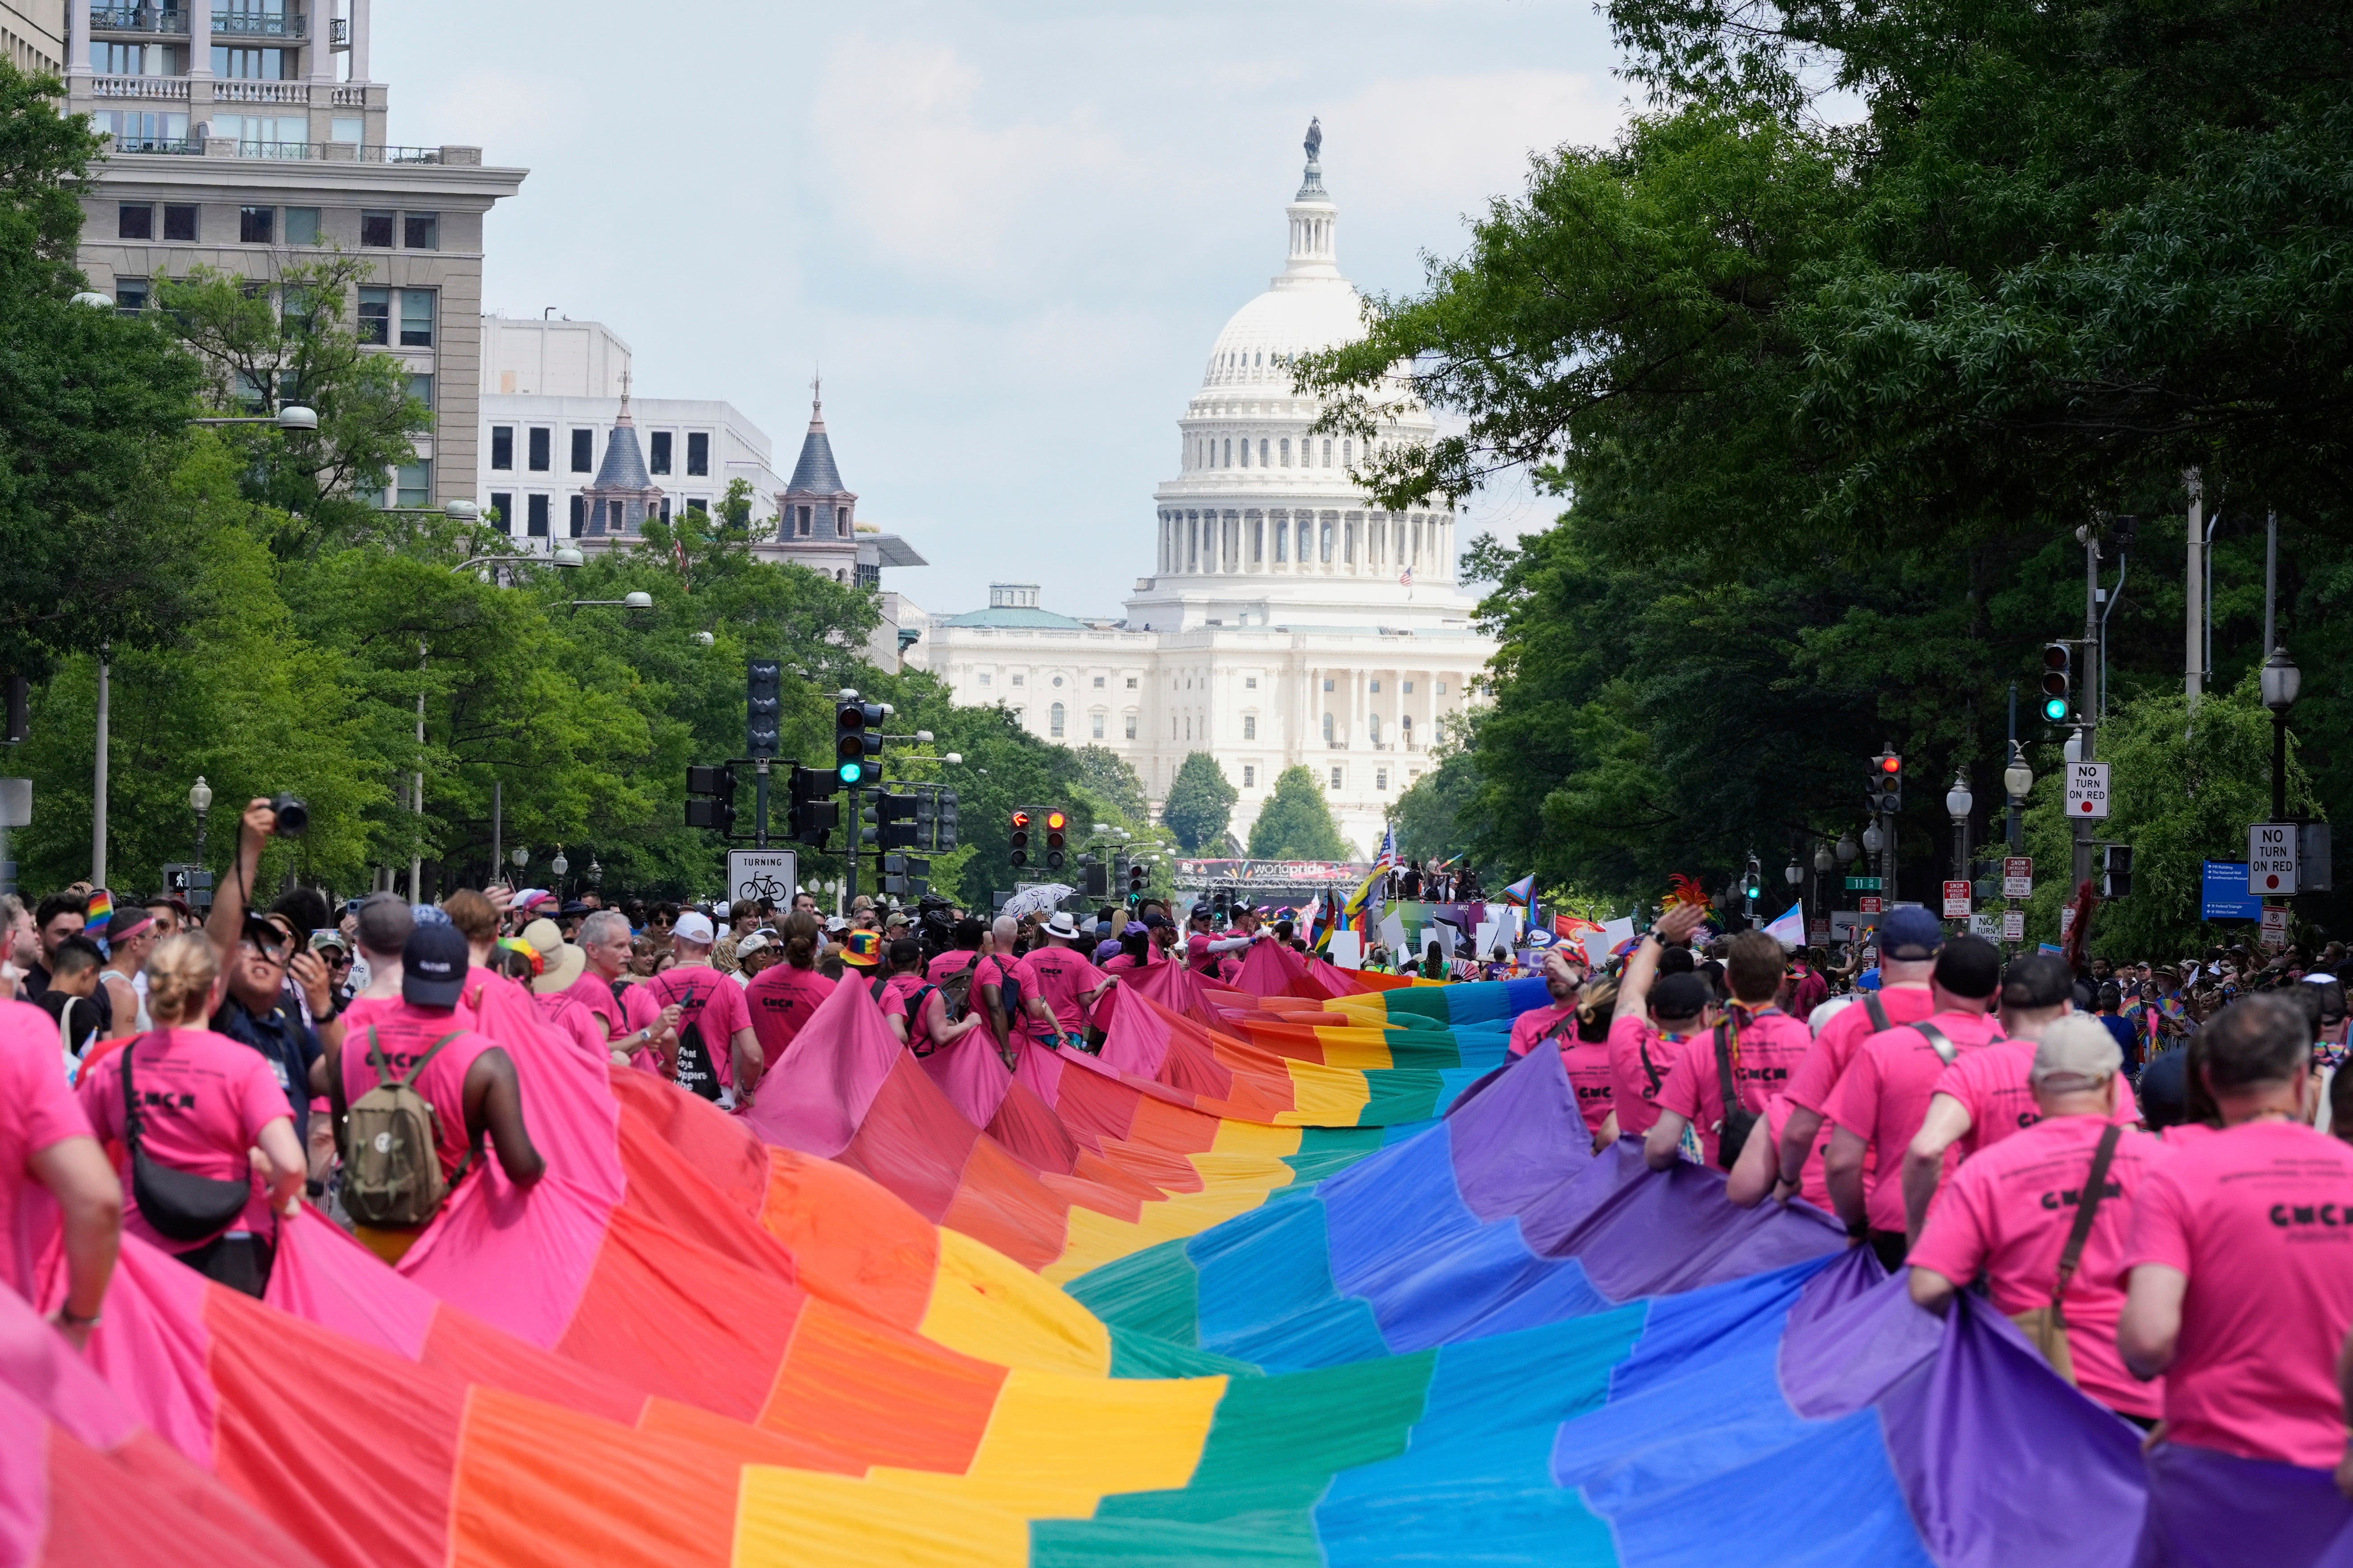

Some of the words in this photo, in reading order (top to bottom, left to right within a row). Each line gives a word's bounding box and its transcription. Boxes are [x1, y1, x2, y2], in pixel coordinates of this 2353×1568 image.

[2079, 766, 2097, 776] NO
[2075, 779, 2100, 788] TURN
[2070, 790, 2082, 799] ON
[2087, 791, 2105, 799] RED
[2263, 829, 2283, 843] NO
[2259, 846, 2287, 857] TURN
[1253, 863, 1326, 876] worldpride
[2253, 861, 2267, 872] ON
[2273, 861, 2292, 872] RED
[1855, 879, 1863, 889] 11
[1979, 917, 1993, 925] NO
[677, 1069, 708, 1082] oppers
